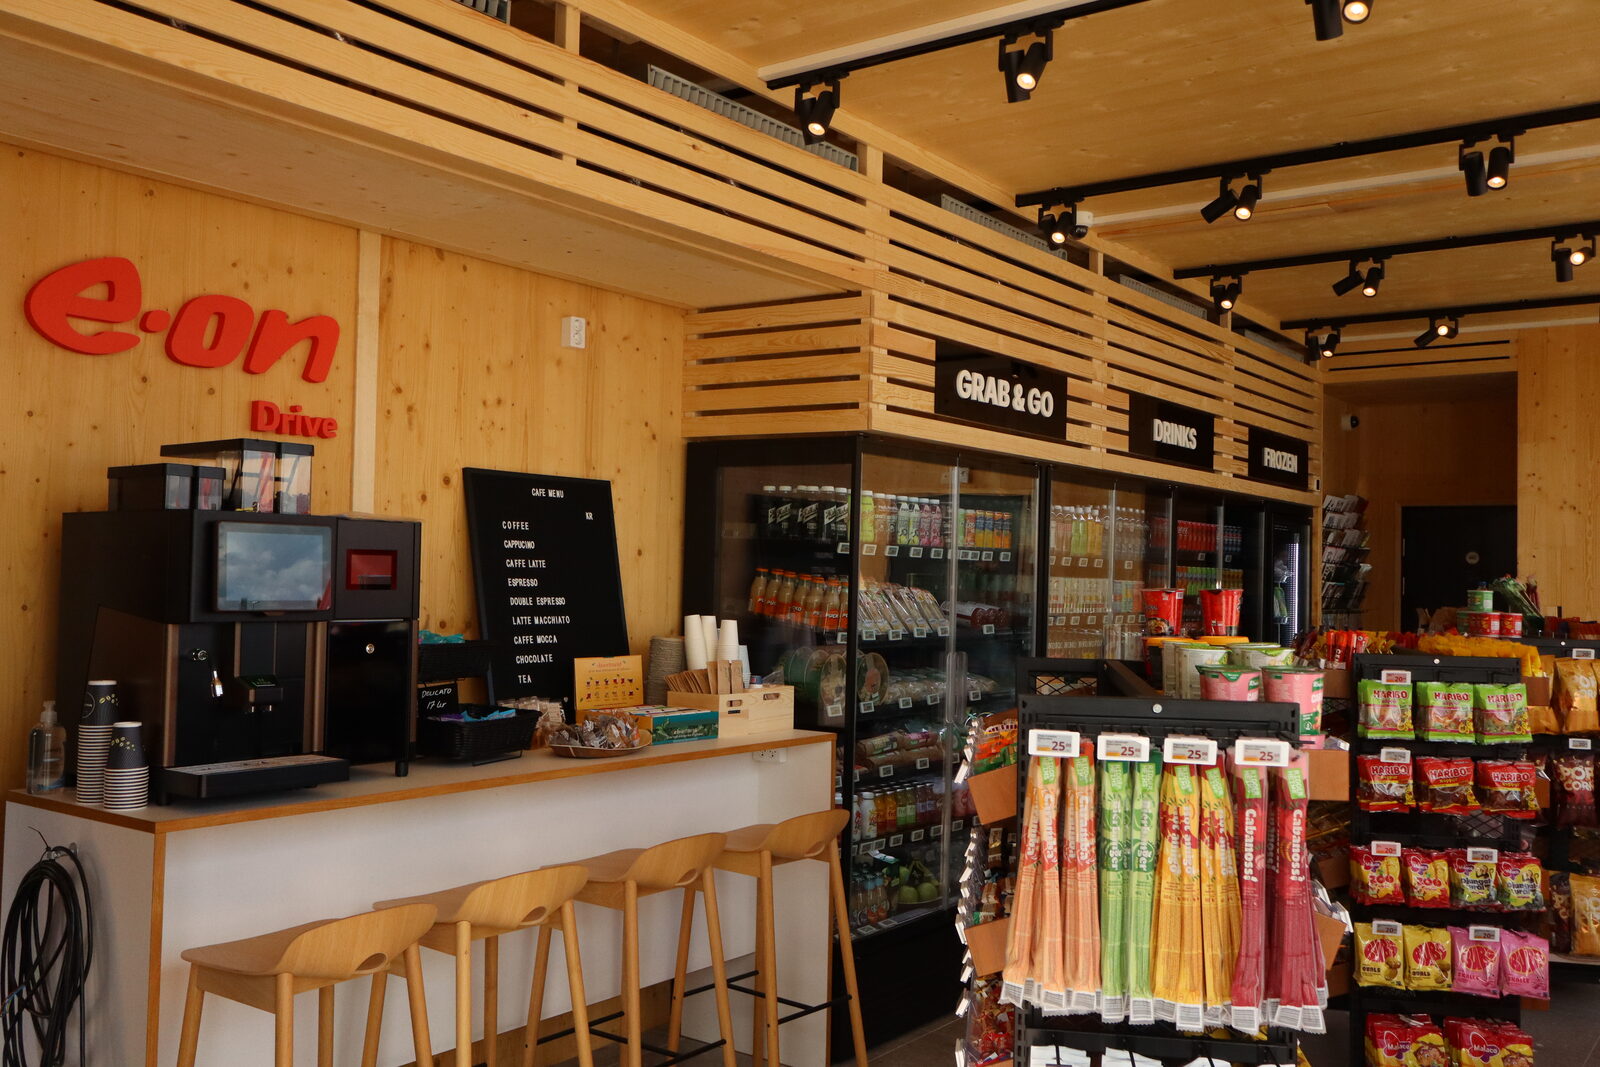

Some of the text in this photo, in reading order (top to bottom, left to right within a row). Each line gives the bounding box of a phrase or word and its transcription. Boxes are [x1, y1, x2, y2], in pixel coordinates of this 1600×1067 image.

[956, 369, 1054, 417] GRAB & GO
[250, 400, 338, 438] Drive
[1153, 418, 1197, 450] DRINKS
[1263, 447, 1298, 473] FROZEN
[532, 488, 564, 498] CAFE MENU
[585, 512, 593, 520] KR
[502, 521, 530, 530] COFFEE
[504, 540, 535, 550] CAPPUCINO
[506, 559, 546, 568] CAFFE LATTE
[508, 578, 538, 587] ESPRESSO
[510, 597, 566, 606] DOUBLE ESPRESSO
[512, 616, 570, 625] LATTE MACCHIATO
[514, 635, 558, 645] CAFFE MOCCA
[516, 654, 553, 664] CHOCOLATE
[518, 674, 532, 684] TEA
[1373, 690, 1408, 699] HARIBO
[1434, 692, 1469, 701] HARIBO
[1488, 694, 1522, 703] HARIBO
[1052, 742, 1065, 751] 25
[1120, 746, 1135, 756] 25
[1188, 750, 1201, 759] 25
[1260, 752, 1274, 761] 25
[1371, 765, 1409, 776] HARIBO
[1430, 767, 1467, 780] HARIBO
[1493, 772, 1530, 782] HARIBO
[1473, 1045, 1498, 1054] Malaco
